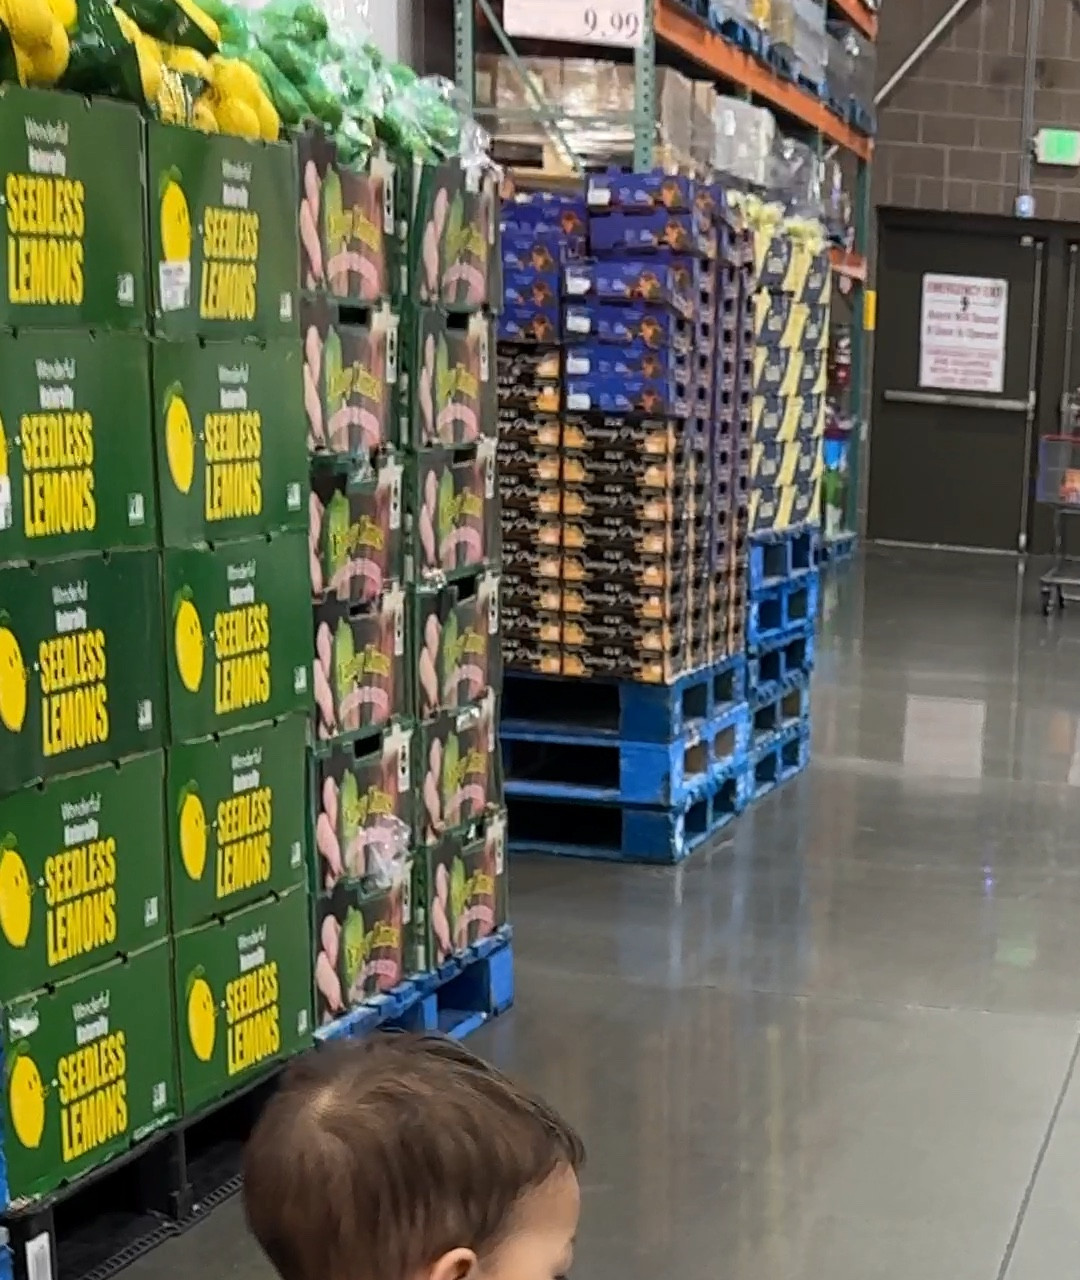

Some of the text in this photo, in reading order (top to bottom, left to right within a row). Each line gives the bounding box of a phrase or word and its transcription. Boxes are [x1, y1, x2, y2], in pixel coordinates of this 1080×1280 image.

[583, 8, 640, 39] 9.99
[6, 172, 85, 237] SEEDLESS
[203, 206, 260, 261] SEEDLESS
[8, 235, 84, 306] LEMONS
[200, 260, 257, 321] LEMONS
[22, 411, 94, 470] SEEDLESS
[205, 411, 262, 462] SEEDLESS
[23, 467, 96, 538] LEMONS
[205, 460, 262, 521] LEMONS
[39, 628, 107, 694] SEEDLESS
[215, 603, 270, 659] SEEDLESS
[215, 650, 271, 715] LEMONS
[42, 682, 109, 757] LEMONS
[217, 786, 272, 846] SEEDLESS
[45, 836, 116, 906] SEEDLESS
[216, 831, 271, 899] LEMONS
[47, 888, 117, 967] LEMONS
[225, 960, 279, 1024] SEEDLESS
[58, 1030, 127, 1105] SEEDLESS
[228, 1004, 280, 1076] LEMONS
[60, 1079, 128, 1163] LEMONS
